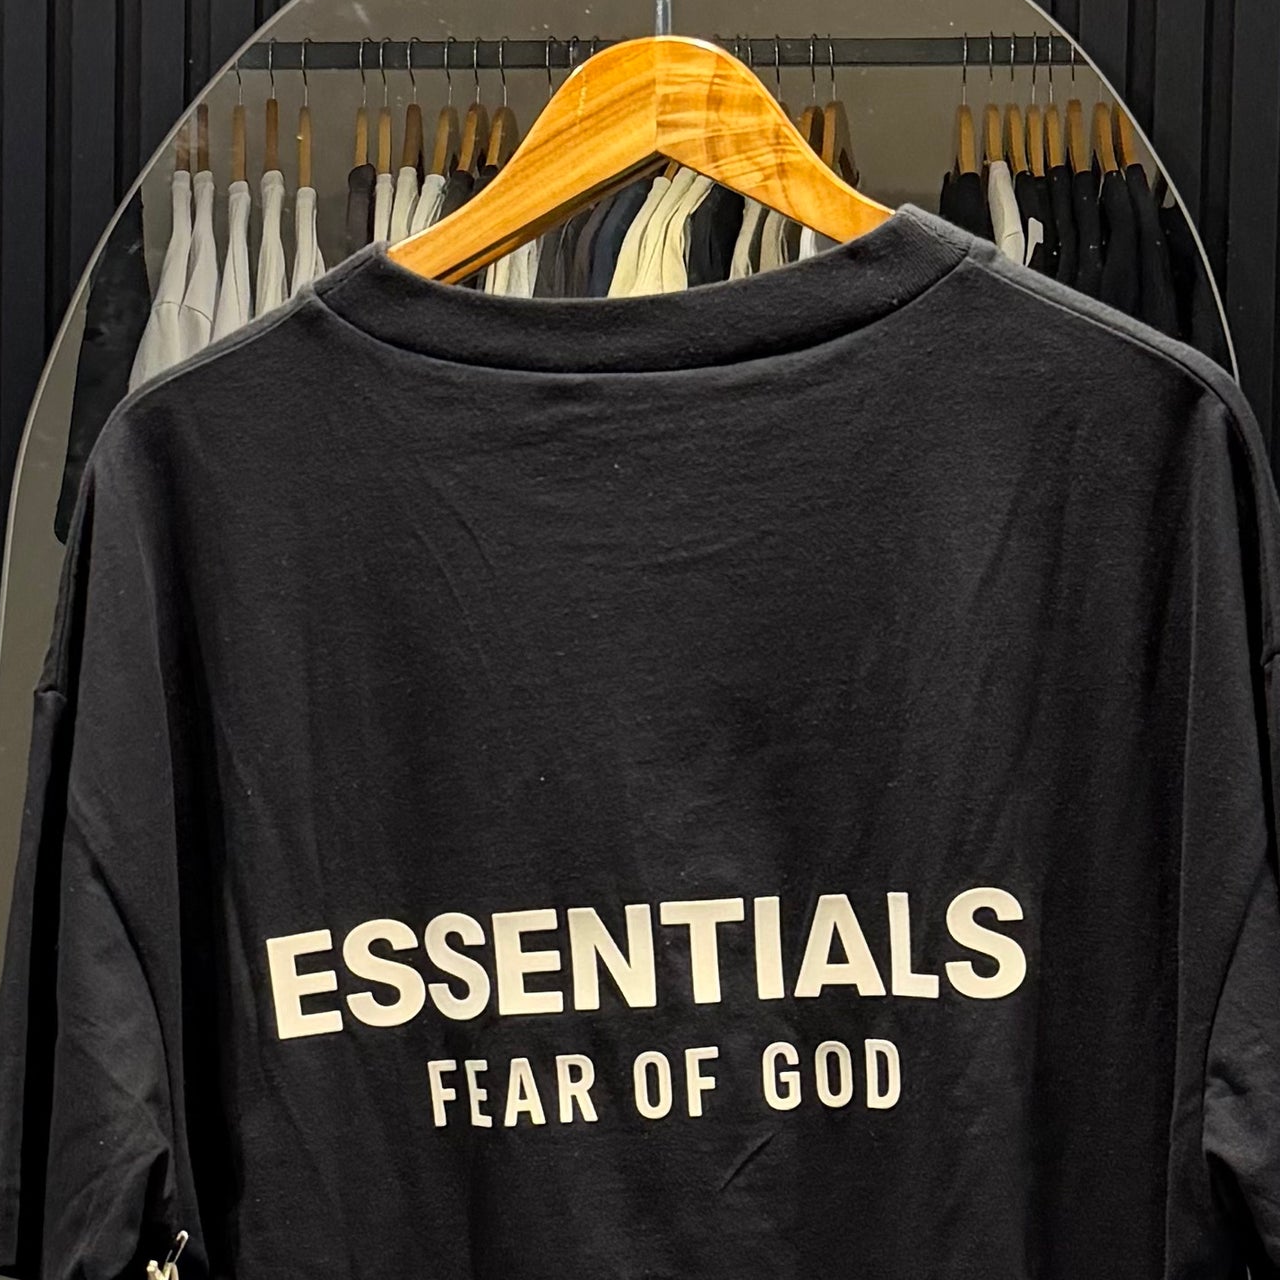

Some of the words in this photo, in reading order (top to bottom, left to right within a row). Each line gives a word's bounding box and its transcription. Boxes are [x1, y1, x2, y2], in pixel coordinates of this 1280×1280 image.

[265, 886, 1027, 1040] ESSENTIALS
[427, 1053, 599, 1129] FEAR
[633, 1045, 719, 1121] OF
[762, 1038, 902, 1111] GOD
